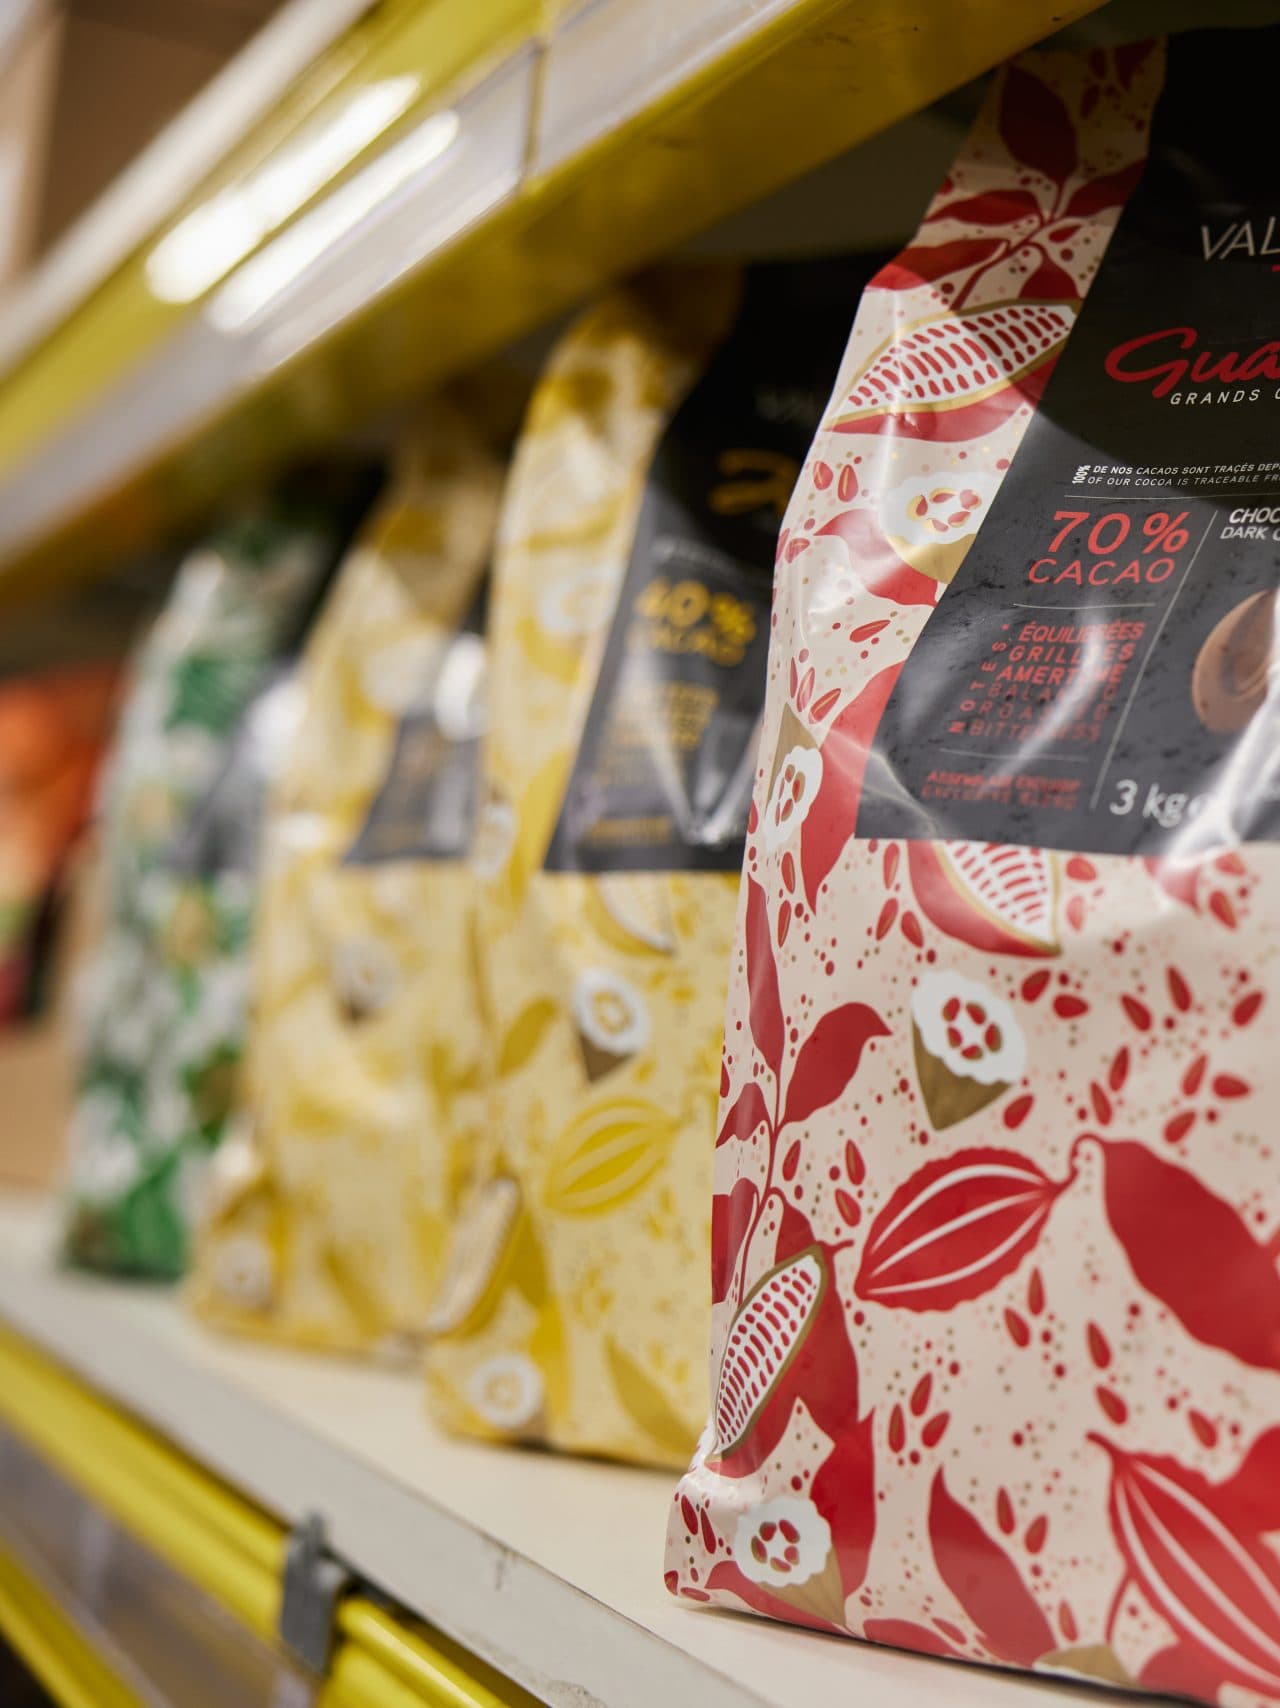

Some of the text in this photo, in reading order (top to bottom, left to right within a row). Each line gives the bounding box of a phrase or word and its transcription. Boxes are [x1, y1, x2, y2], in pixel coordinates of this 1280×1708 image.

[1170, 389, 1260, 406] GRANDS
[1087, 476, 1103, 485] OF
[1107, 477, 1130, 486] OUR
[1134, 478, 1173, 486] COCOA
[1177, 478, 1189, 486] IS
[1194, 475, 1260, 486] TRACEABLE
[1093, 466, 1108, 474] DE
[1110, 466, 1133, 475] NOS
[1136, 467, 1178, 475] CACAOS
[1181, 466, 1210, 475] SONT
[1220, 526, 1269, 540] DARK
[1028, 558, 1175, 585] CACAO
[1019, 619, 1145, 643] ÉQUILIÉES
[1009, 642, 1136, 664] GRILLES
[997, 663, 1127, 685] AMERTME
[988, 682, 1117, 701] BALAD
[979, 700, 1110, 721] ROAD
[1110, 779, 1137, 815] 3
[1143, 783, 1188, 828] kg
